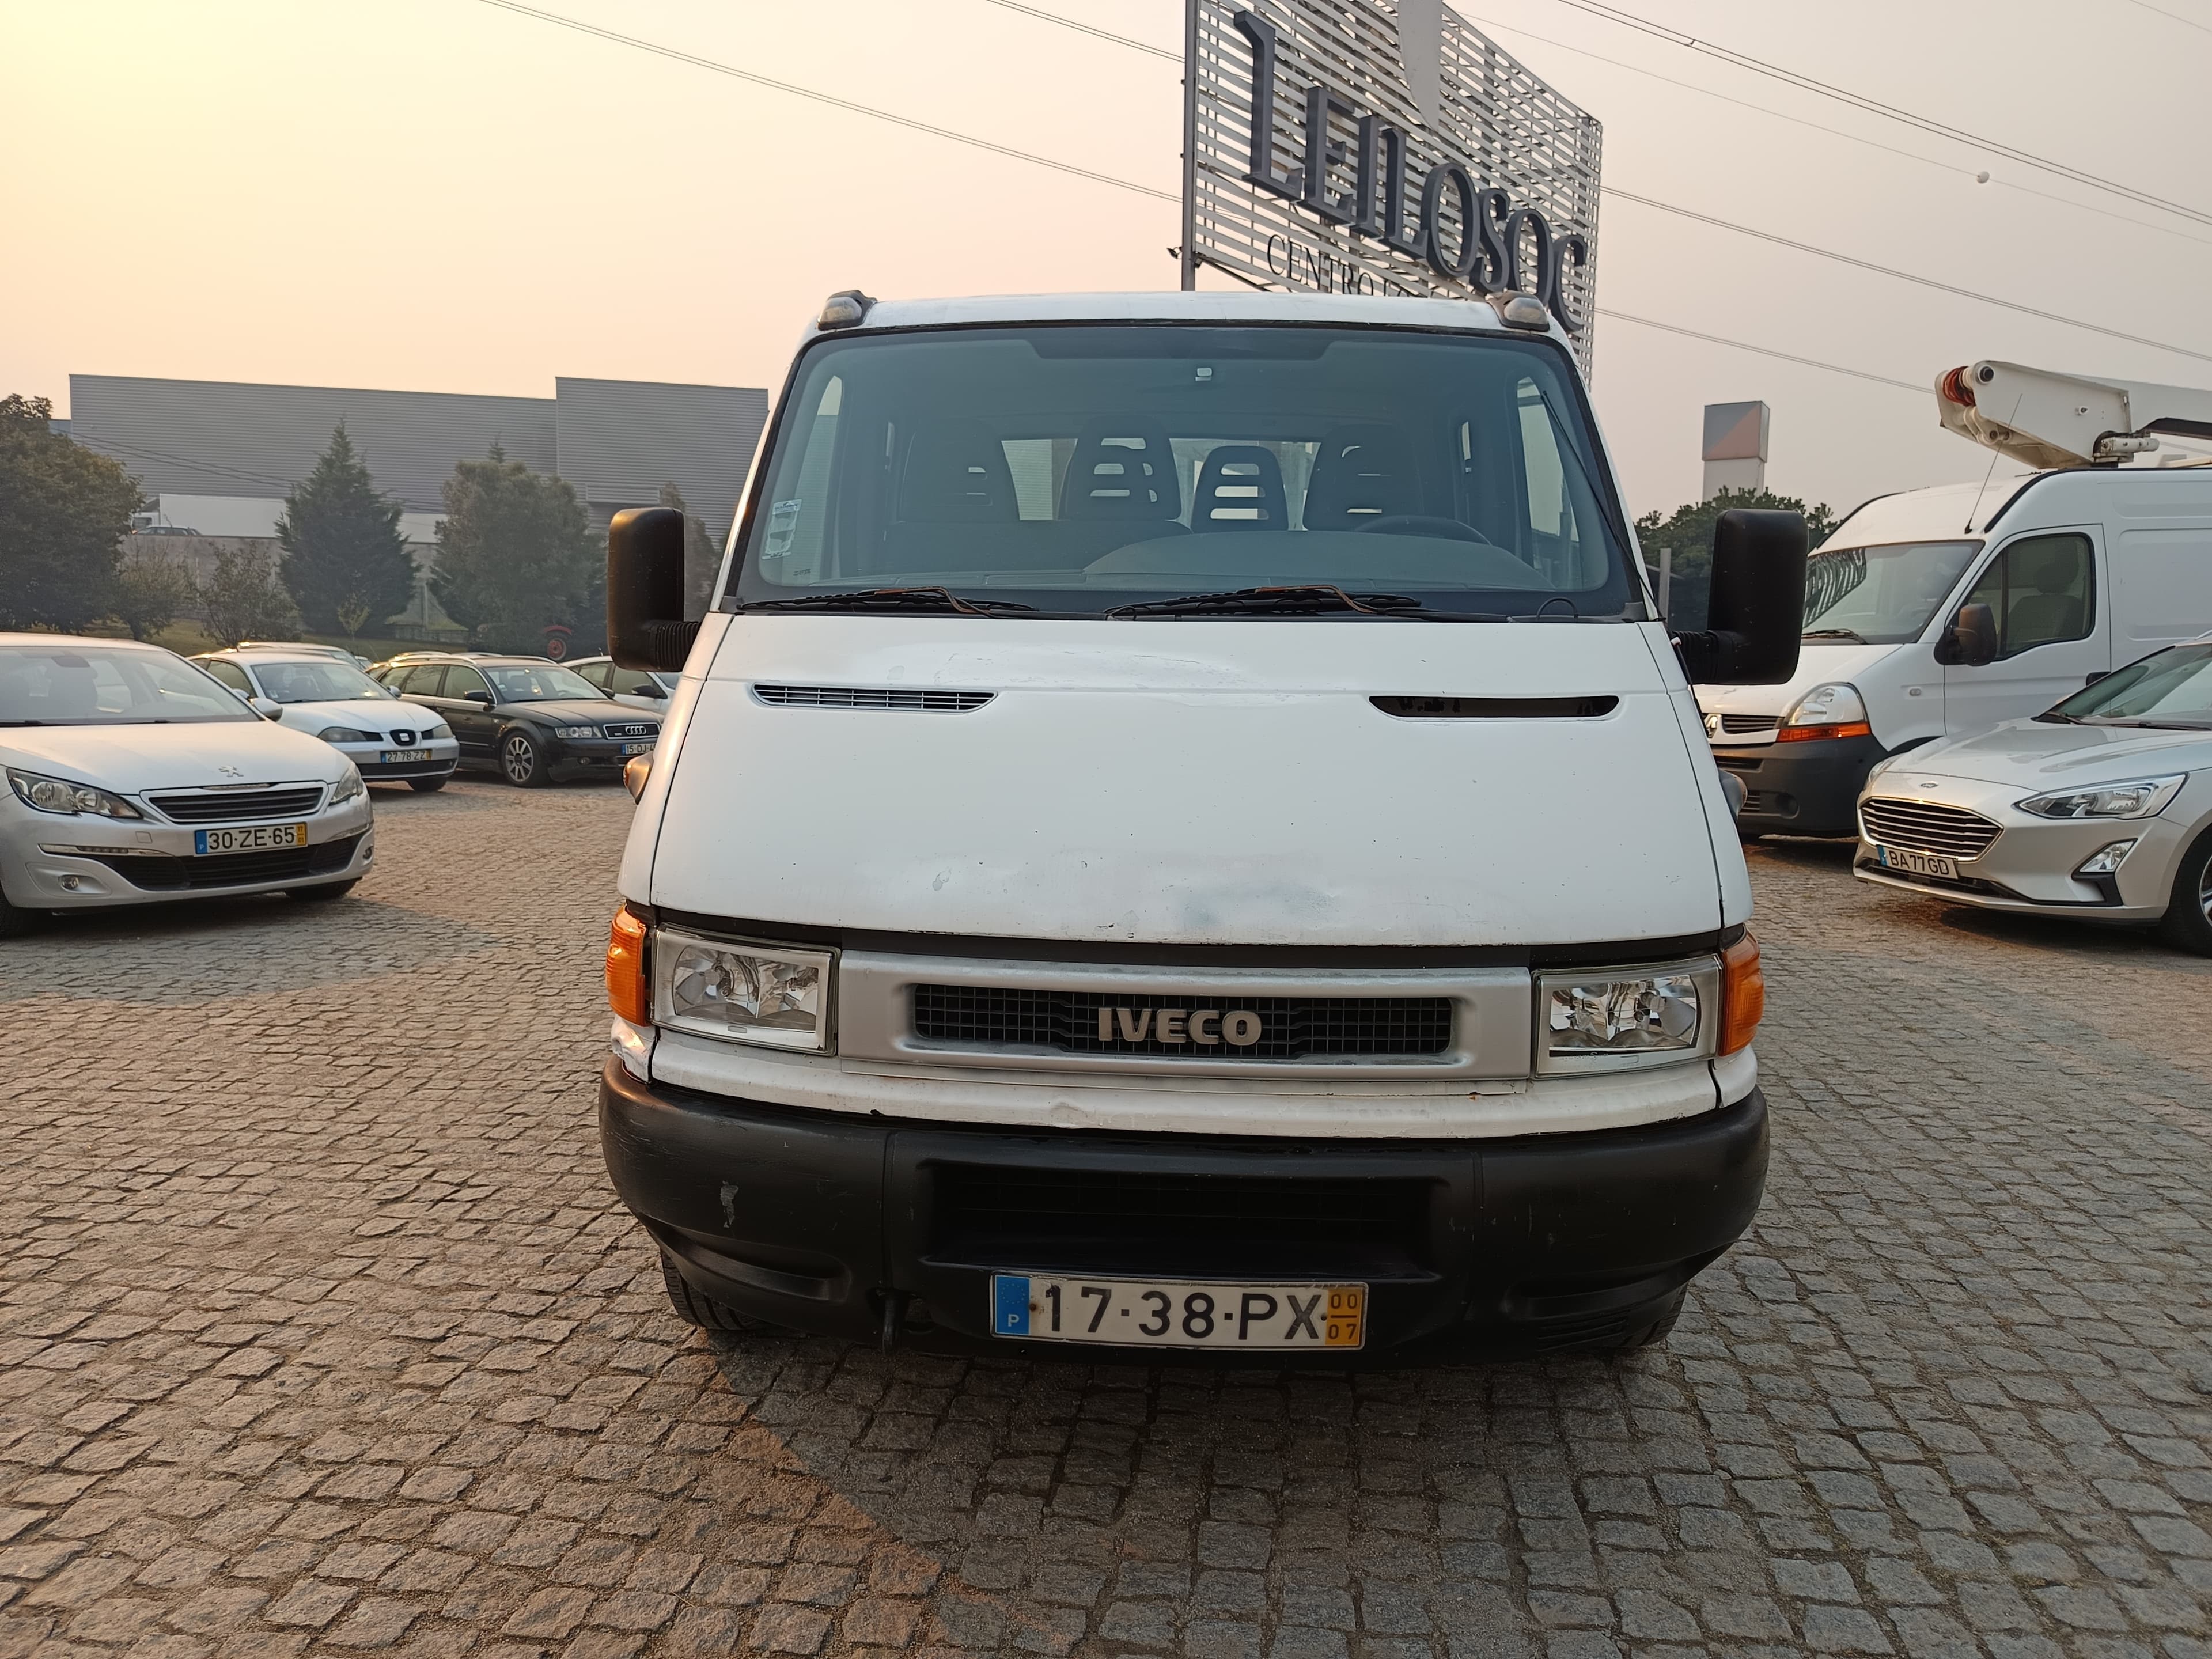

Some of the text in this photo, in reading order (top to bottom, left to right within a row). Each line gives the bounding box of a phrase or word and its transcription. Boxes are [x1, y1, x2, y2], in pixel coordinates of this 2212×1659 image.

[1234, 10, 1588, 332] LEILOSOC
[1267, 234, 1374, 296] CENTRO
[1098, 1007, 1262, 1046] IVECO
[1331, 1294, 1357, 1309] 00
[1007, 1313, 1020, 1328] P
[1328, 1323, 1357, 1339] 07
